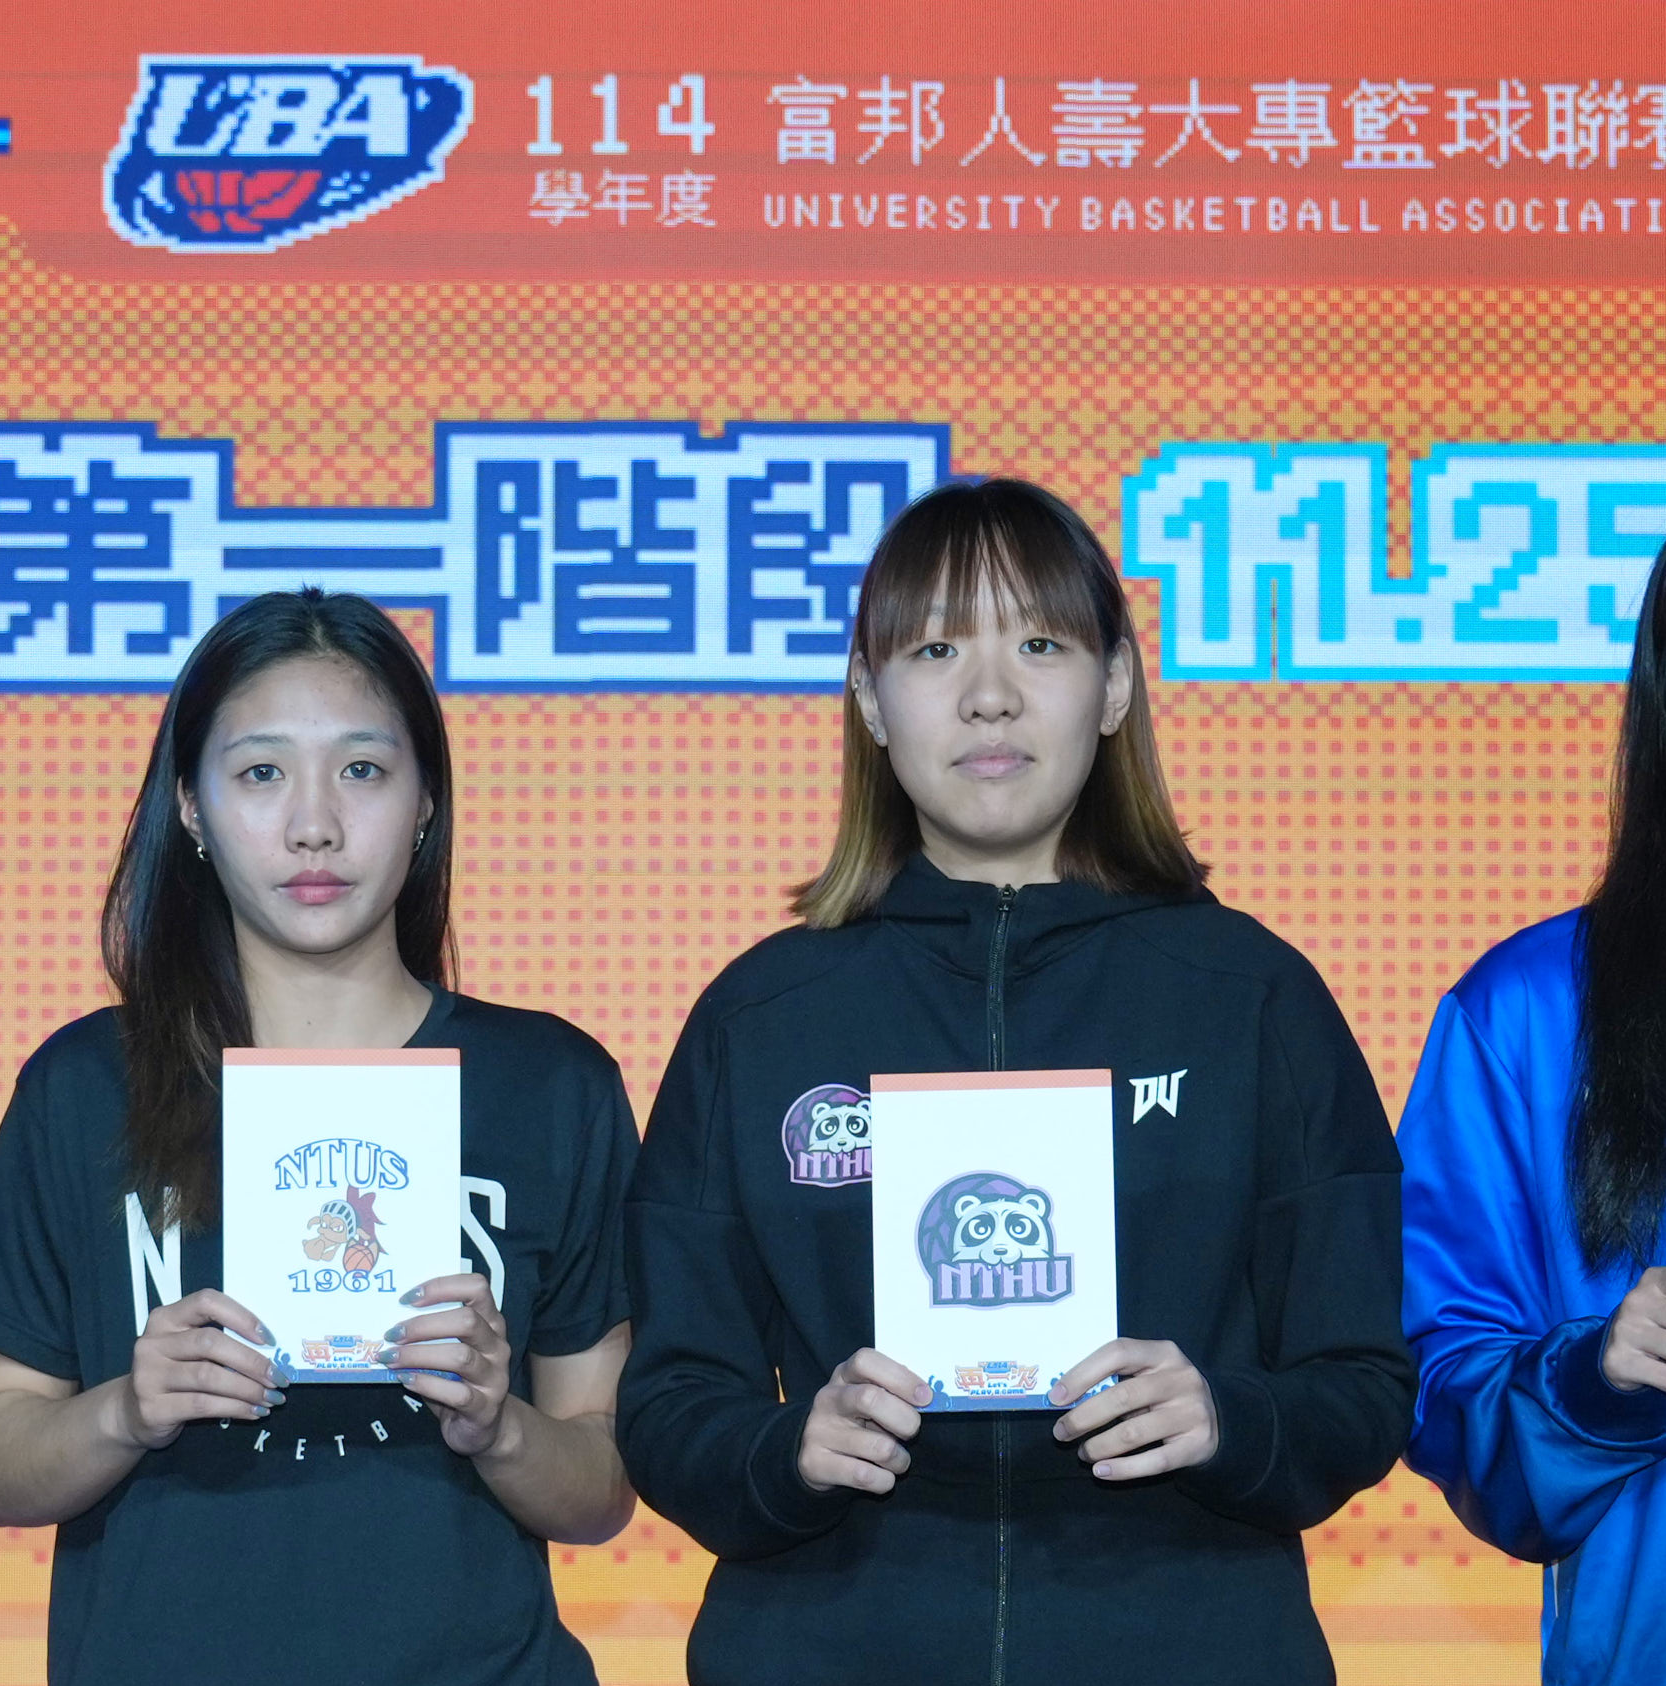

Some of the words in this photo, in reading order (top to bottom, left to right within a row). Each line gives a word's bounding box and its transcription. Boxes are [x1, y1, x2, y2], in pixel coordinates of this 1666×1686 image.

[146, 74, 410, 158] UBA
[526, 73, 716, 156] 114
[527, 168, 718, 227] 學年度
[763, 194, 1060, 232] UNIVERSITY
[1079, 194, 1381, 232] BASKETBALL
[275, 1137, 410, 1191] NTUS
[124, 1174, 508, 1338] NS
[288, 1268, 397, 1293] 1961
[938, 1258, 1071, 1300] NTHU
